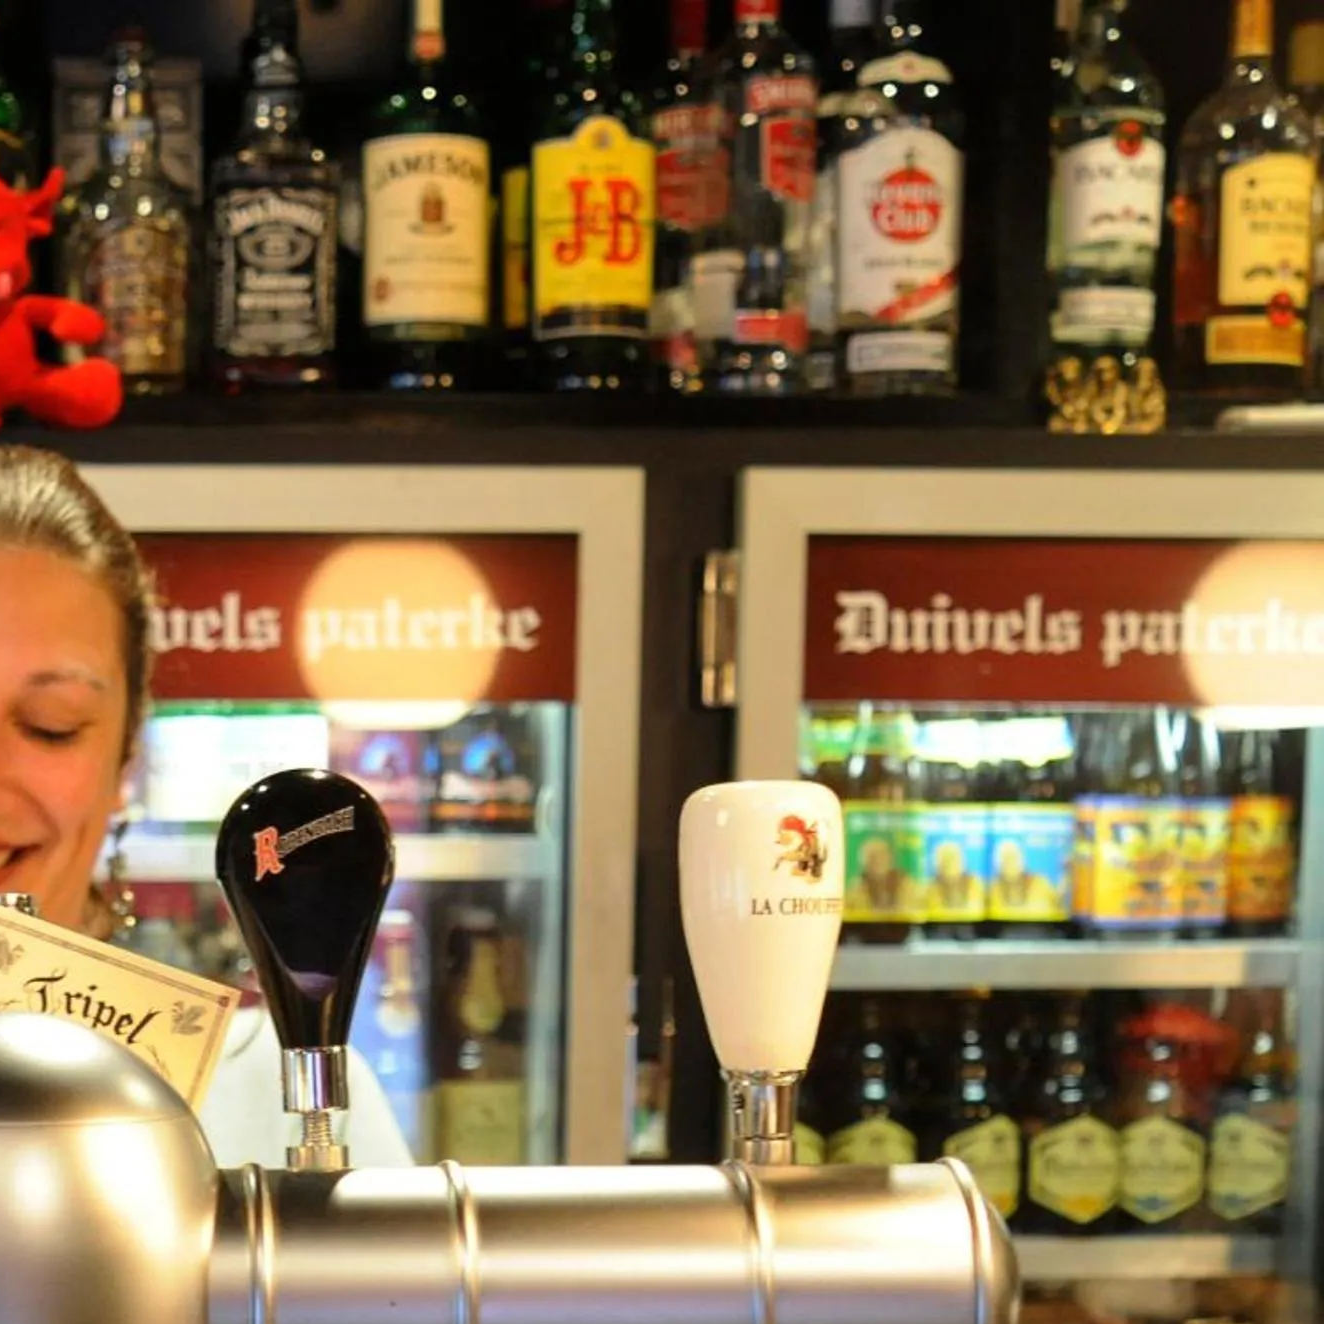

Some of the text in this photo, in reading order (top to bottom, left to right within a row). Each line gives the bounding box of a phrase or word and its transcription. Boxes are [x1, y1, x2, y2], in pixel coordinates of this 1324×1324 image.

[148, 592, 542, 663] vels paterke
[834, 589, 1082, 654] Duivels
[751, 898, 773, 915] LA
[23, 968, 163, 1045] Tripel
